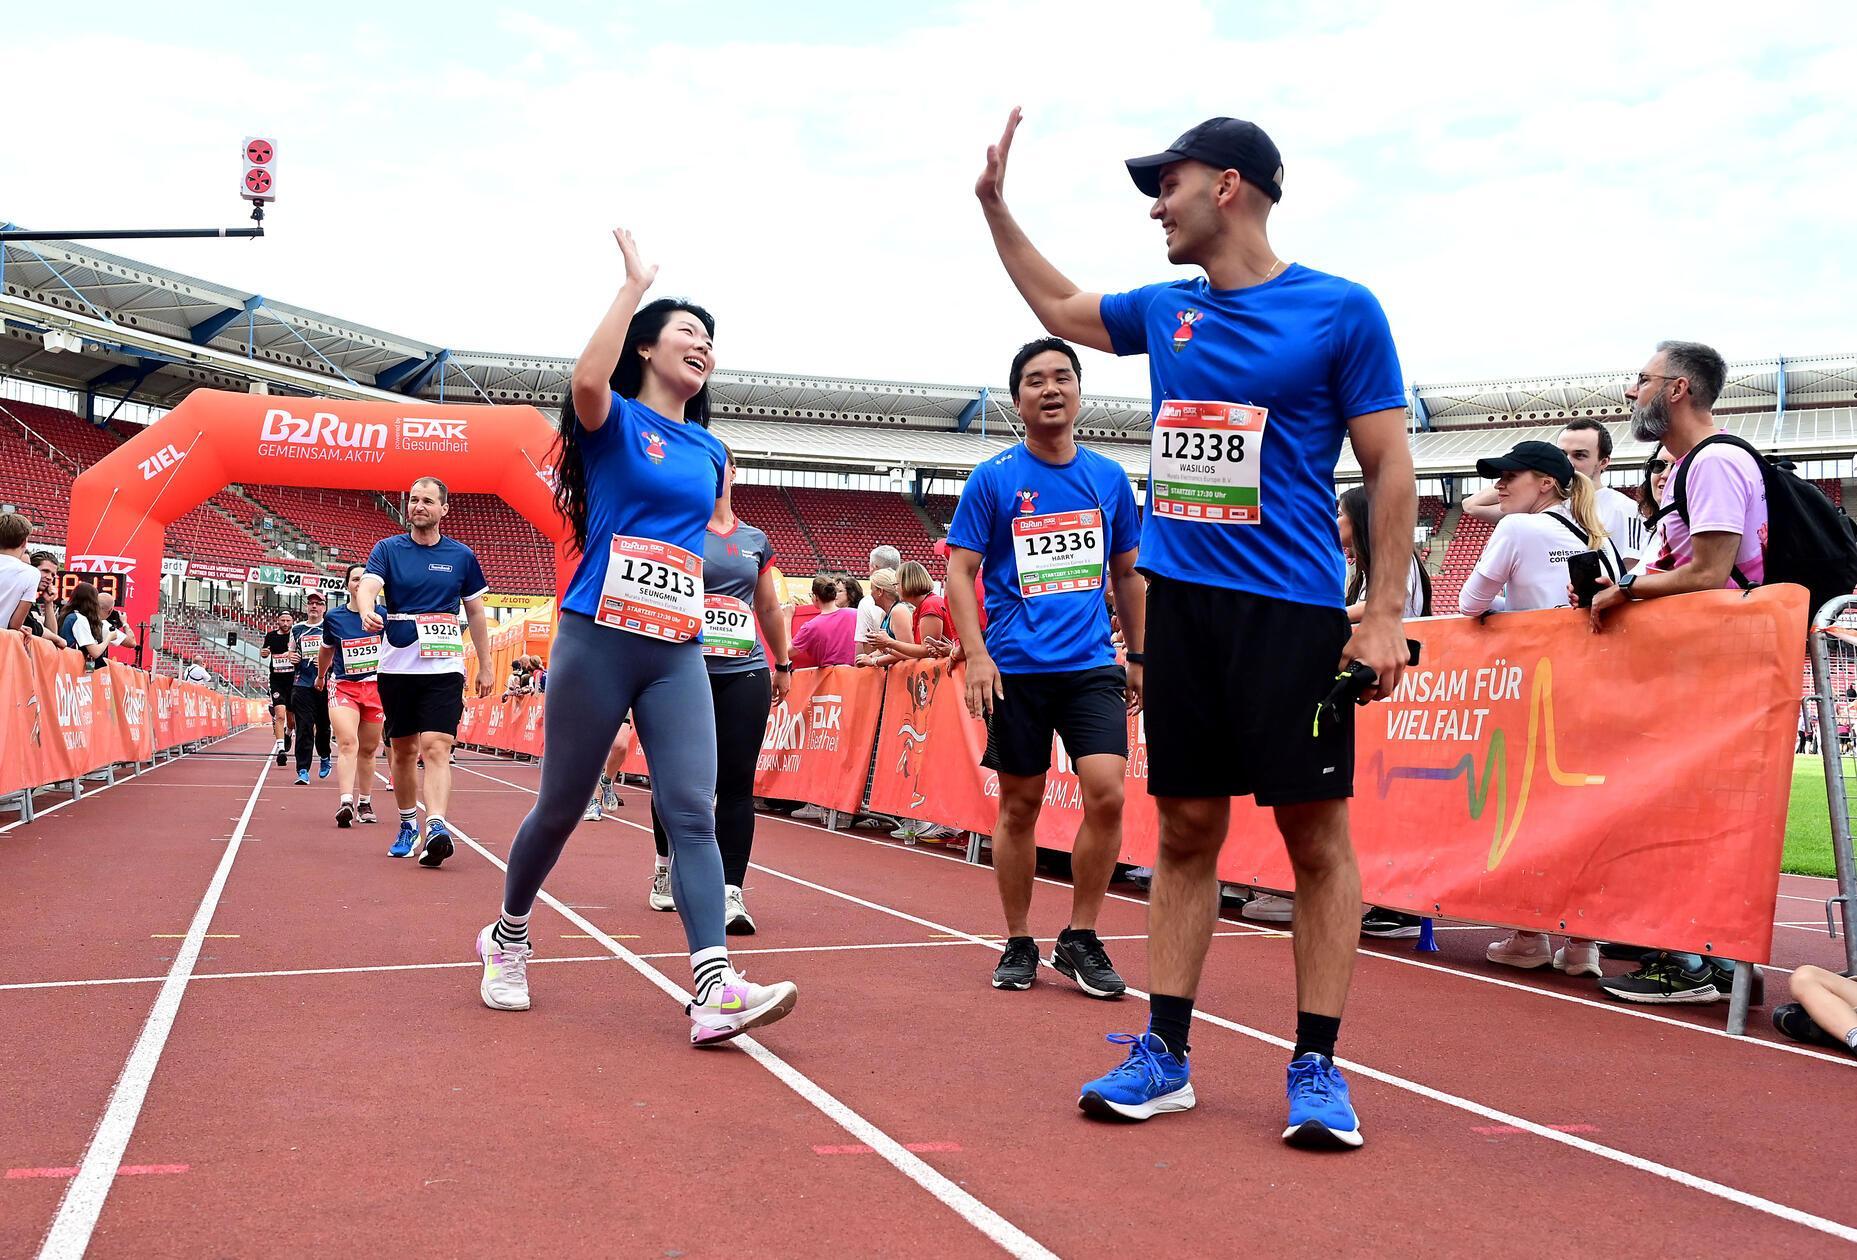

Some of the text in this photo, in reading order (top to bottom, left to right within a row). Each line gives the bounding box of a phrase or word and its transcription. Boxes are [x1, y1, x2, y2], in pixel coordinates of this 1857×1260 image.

[260, 408, 389, 449] B2Run
[402, 417, 468, 439] DAK
[401, 437, 469, 452] Gesundheit
[1161, 431, 1245, 463] 12338
[137, 443, 187, 481] ZIEL
[1179, 463, 1216, 474] WASILIOS
[1025, 531, 1096, 556] 12336
[1051, 553, 1075, 561] HARRY
[621, 559, 695, 598] 12313
[639, 587, 678, 603] SEUNGMIN
[626, 605, 657, 617] STARTZEIT
[704, 610, 748, 628] 9507
[423, 624, 458, 637] 19216
[687, 618, 696, 629] D
[709, 625, 733, 633] THERESA
[346, 645, 378, 658] 19259
[1473, 658, 1523, 701] FÜR
[1386, 708, 1490, 741] VIELFALT
